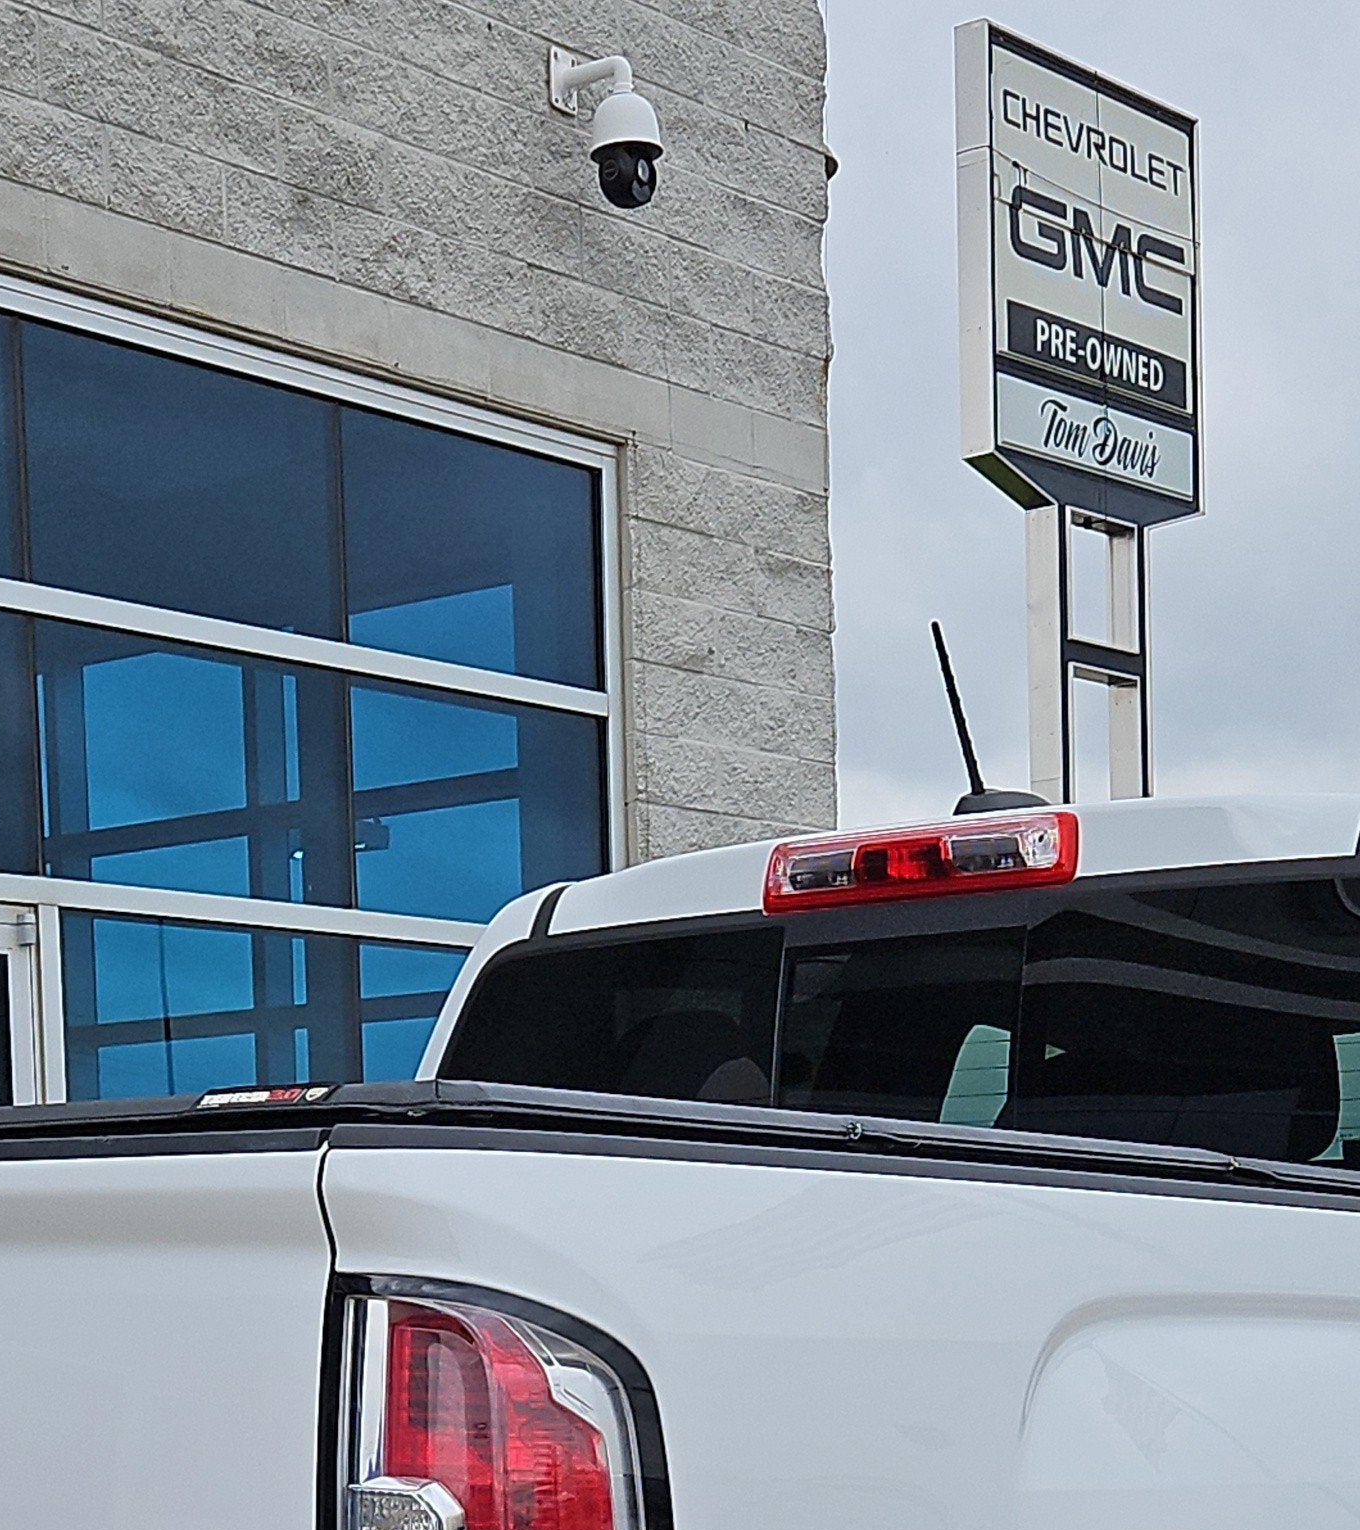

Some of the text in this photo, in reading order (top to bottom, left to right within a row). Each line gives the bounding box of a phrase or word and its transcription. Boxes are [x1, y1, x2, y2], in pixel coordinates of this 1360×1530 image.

[1002, 87, 1187, 197] CHEVROLET
[1009, 184, 1186, 317] GMC
[1036, 318, 1165, 392] PRE-OWNED
[1040, 398, 1161, 479] Tom Davis
